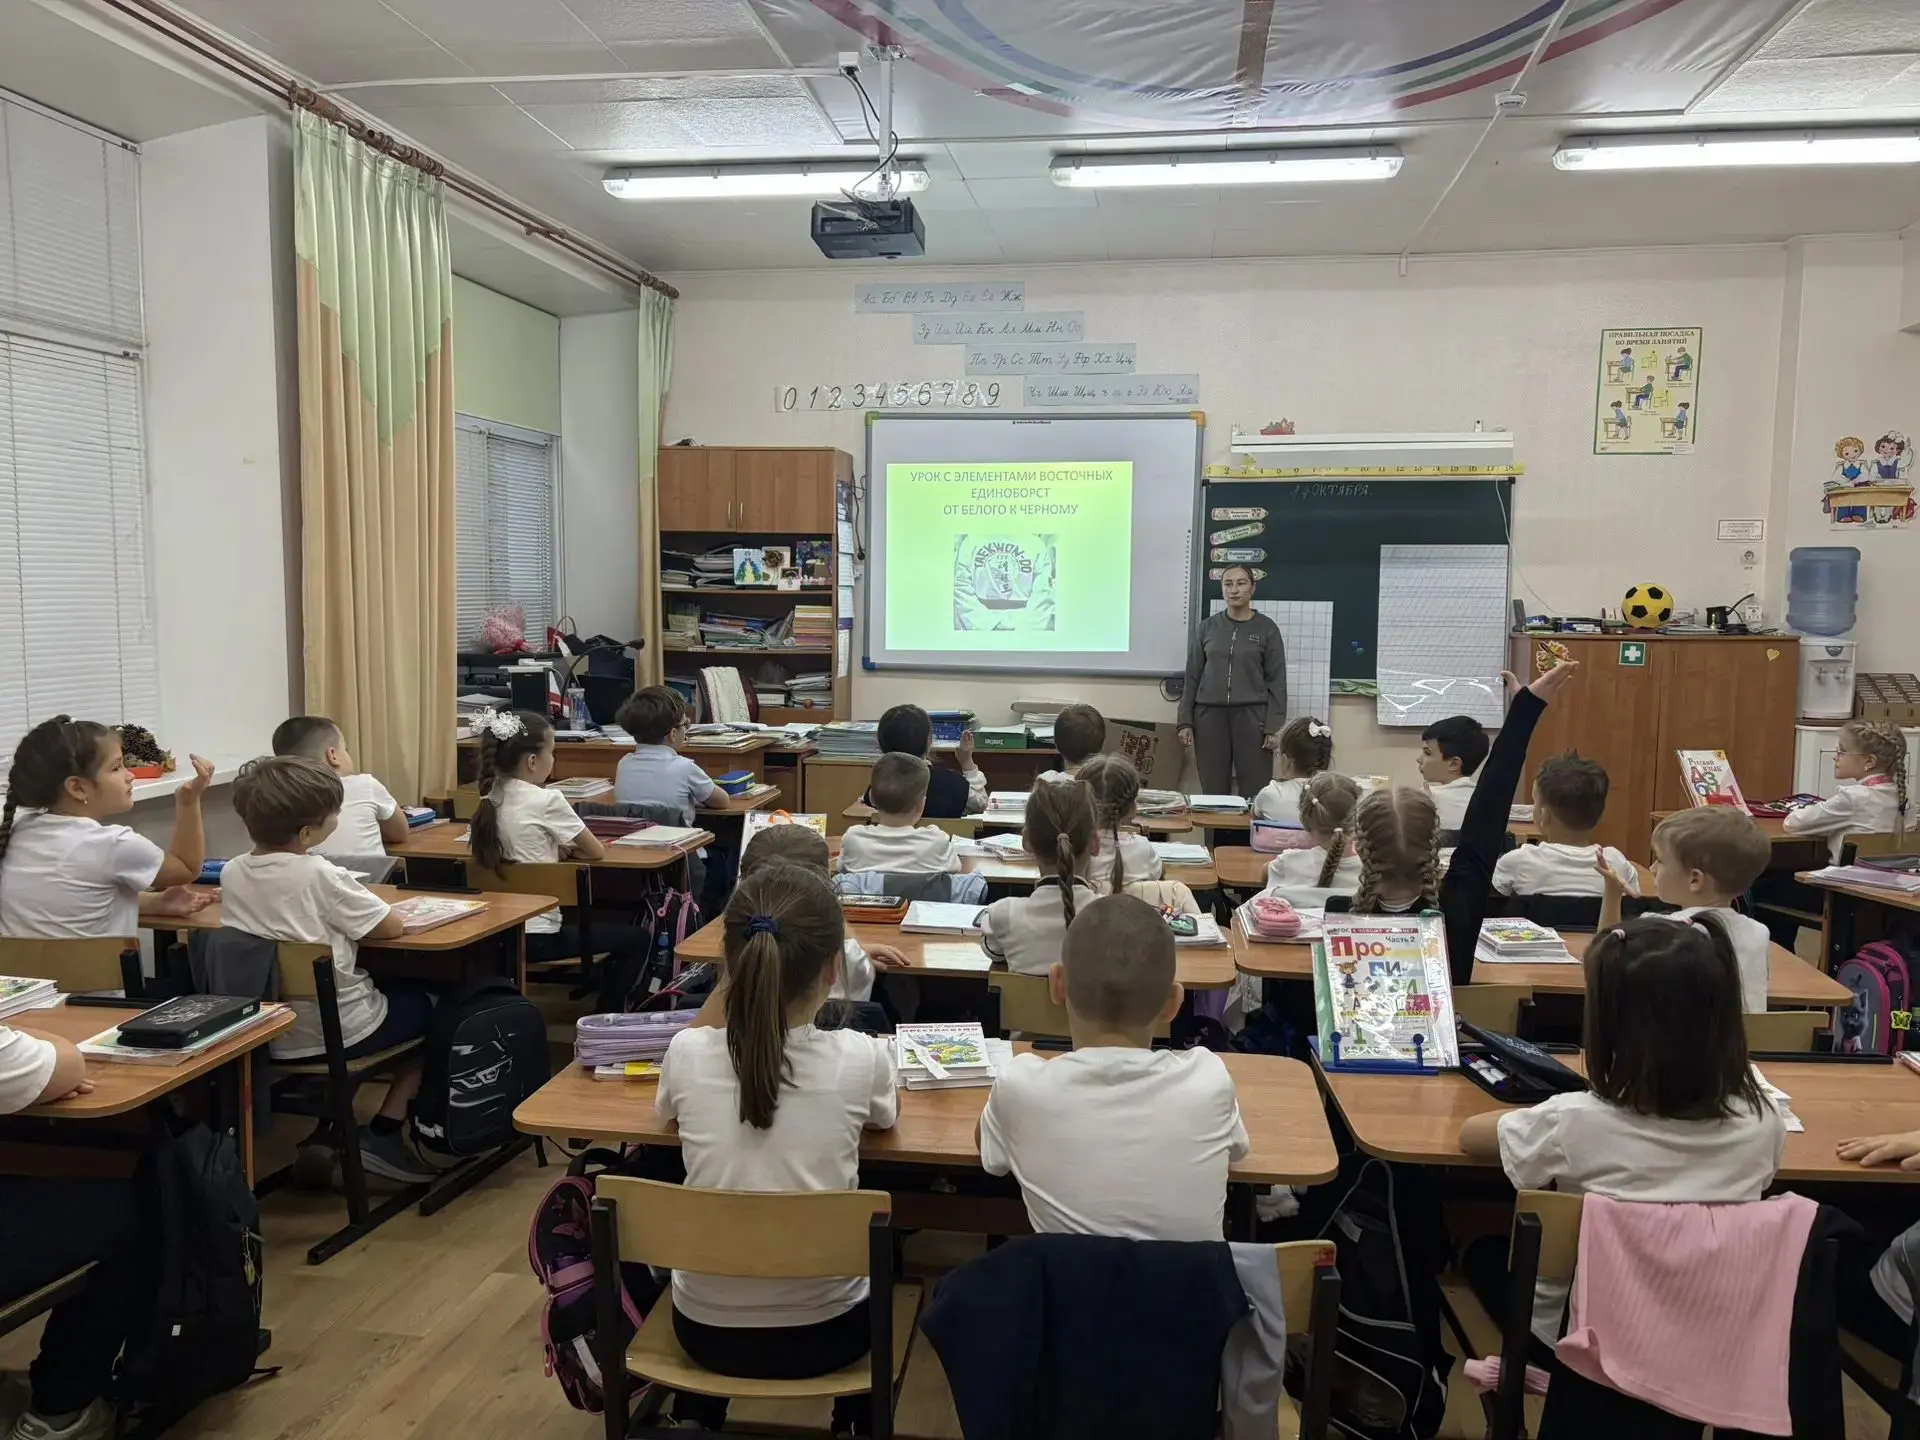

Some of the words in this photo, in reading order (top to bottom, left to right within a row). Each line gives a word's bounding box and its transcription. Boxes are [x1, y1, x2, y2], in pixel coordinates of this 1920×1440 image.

[1000, 290, 1022, 302] Жж
[918, 323, 930, 339] Зз
[976, 321, 995, 334] Кк
[1019, 321, 1042, 334] Мм
[1045, 320, 1064, 333] Нн
[1608, 331, 1659, 339] ПРАВИЛЬНАЯ
[1660, 329, 1696, 338] ПОСАДКА
[1651, 337, 1688, 345] ЗАНЯТИЙ
[1010, 352, 1024, 365] Сс
[1093, 351, 1112, 364] Хх
[783, 386, 797, 410] 0
[809, 385, 819, 409] 1
[828, 386, 842, 409] 2
[851, 383, 865, 407] 3
[875, 383, 887, 407] 4
[895, 383, 909, 406] 5
[918, 382, 932, 406] 6
[942, 383, 954, 407] 7
[962, 383, 977, 406] 8
[988, 383, 1001, 407] 9
[910, 471, 941, 483] УРОК
[944, 471, 952, 482] С
[954, 471, 1037, 482] ЭЛЕМЕНТАМИ
[1040, 470, 1113, 481] ВОСТОЧНЫХ
[971, 487, 1050, 499] ЕДИНОБОРСТ
[943, 505, 959, 516] ОТ
[961, 504, 1007, 515] БЕЛОГО
[1009, 505, 1017, 515] К
[1019, 504, 1079, 515] ЧЕРНОМУ
[974, 542, 1033, 574] TAEKWON-DO
[1688, 757, 1715, 767] Русский
